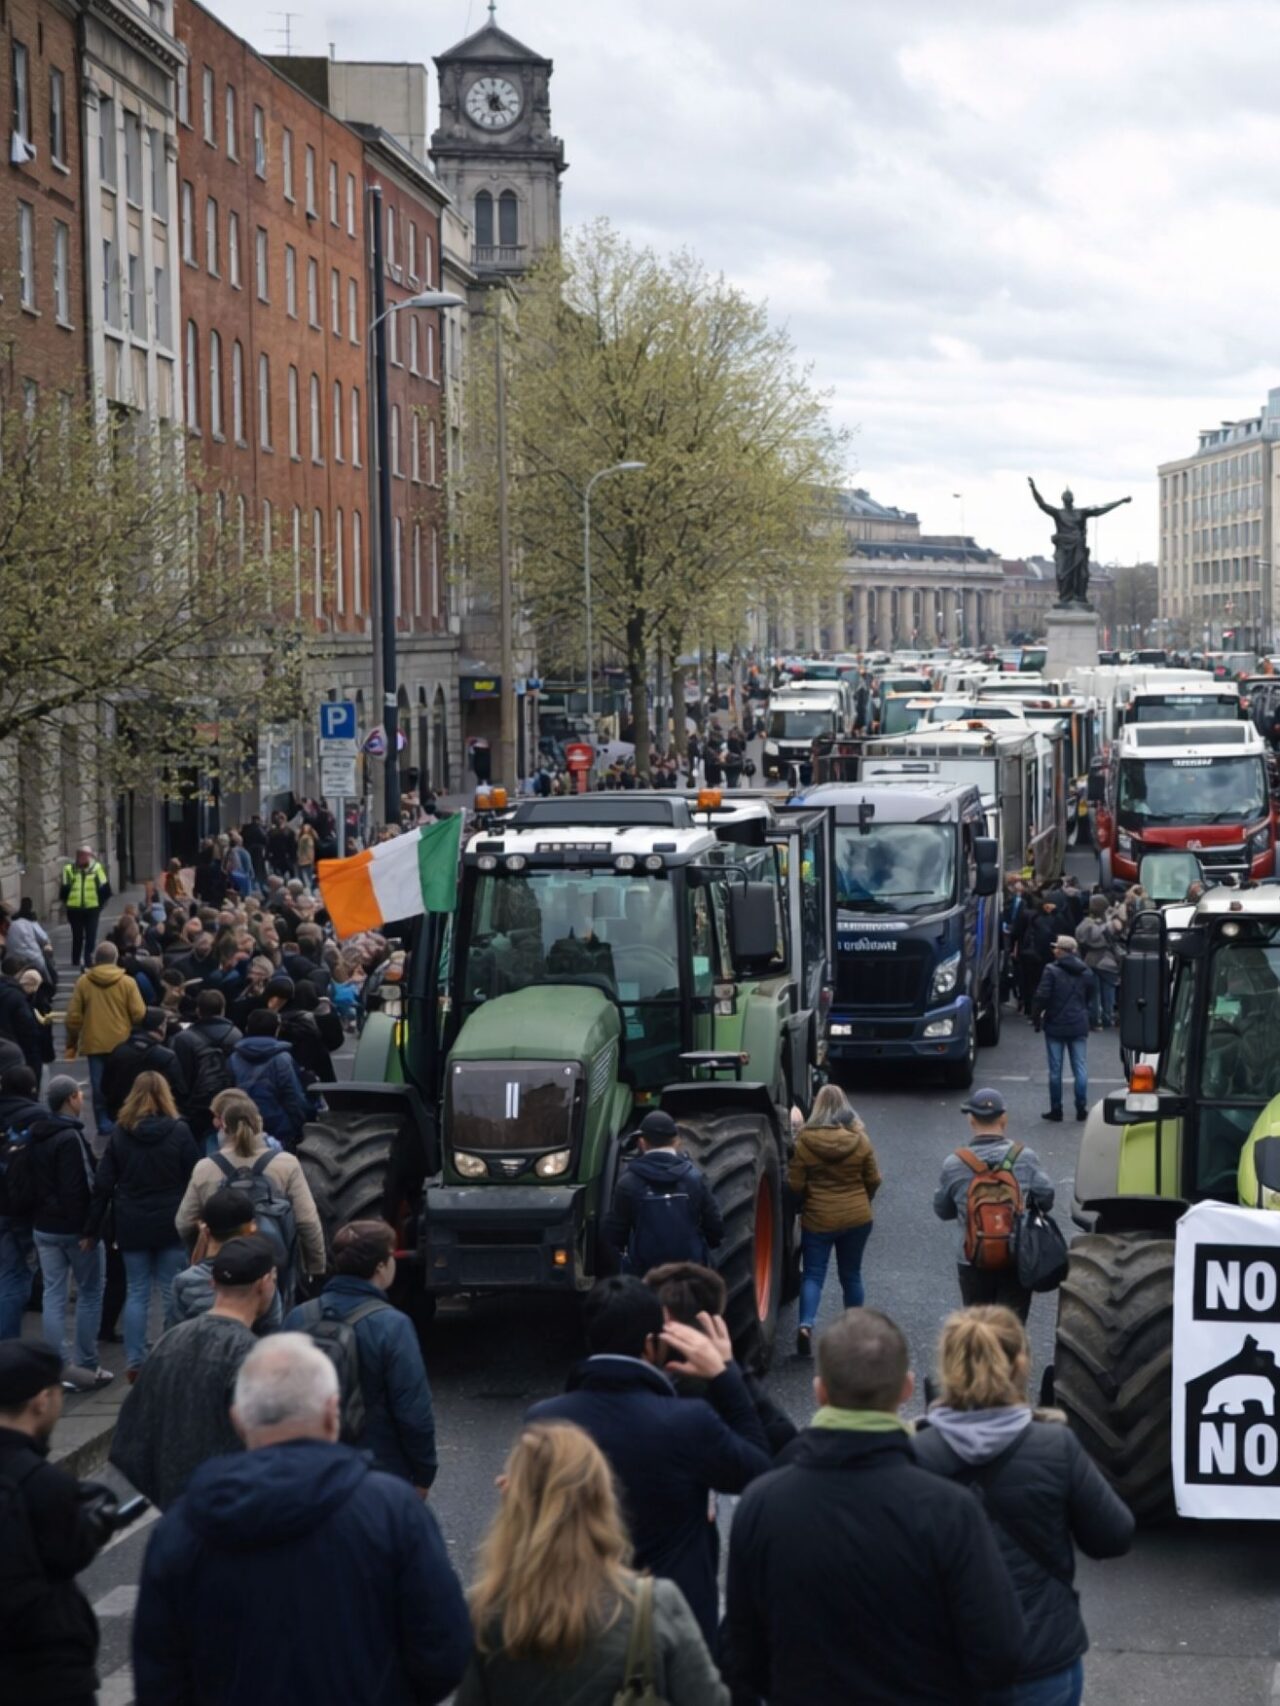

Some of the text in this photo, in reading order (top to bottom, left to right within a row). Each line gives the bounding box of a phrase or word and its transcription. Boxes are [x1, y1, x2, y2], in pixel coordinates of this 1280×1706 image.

[327, 706, 348, 736] P
[1205, 1260, 1278, 1312] NO
[1199, 1422, 1279, 1477] NO
